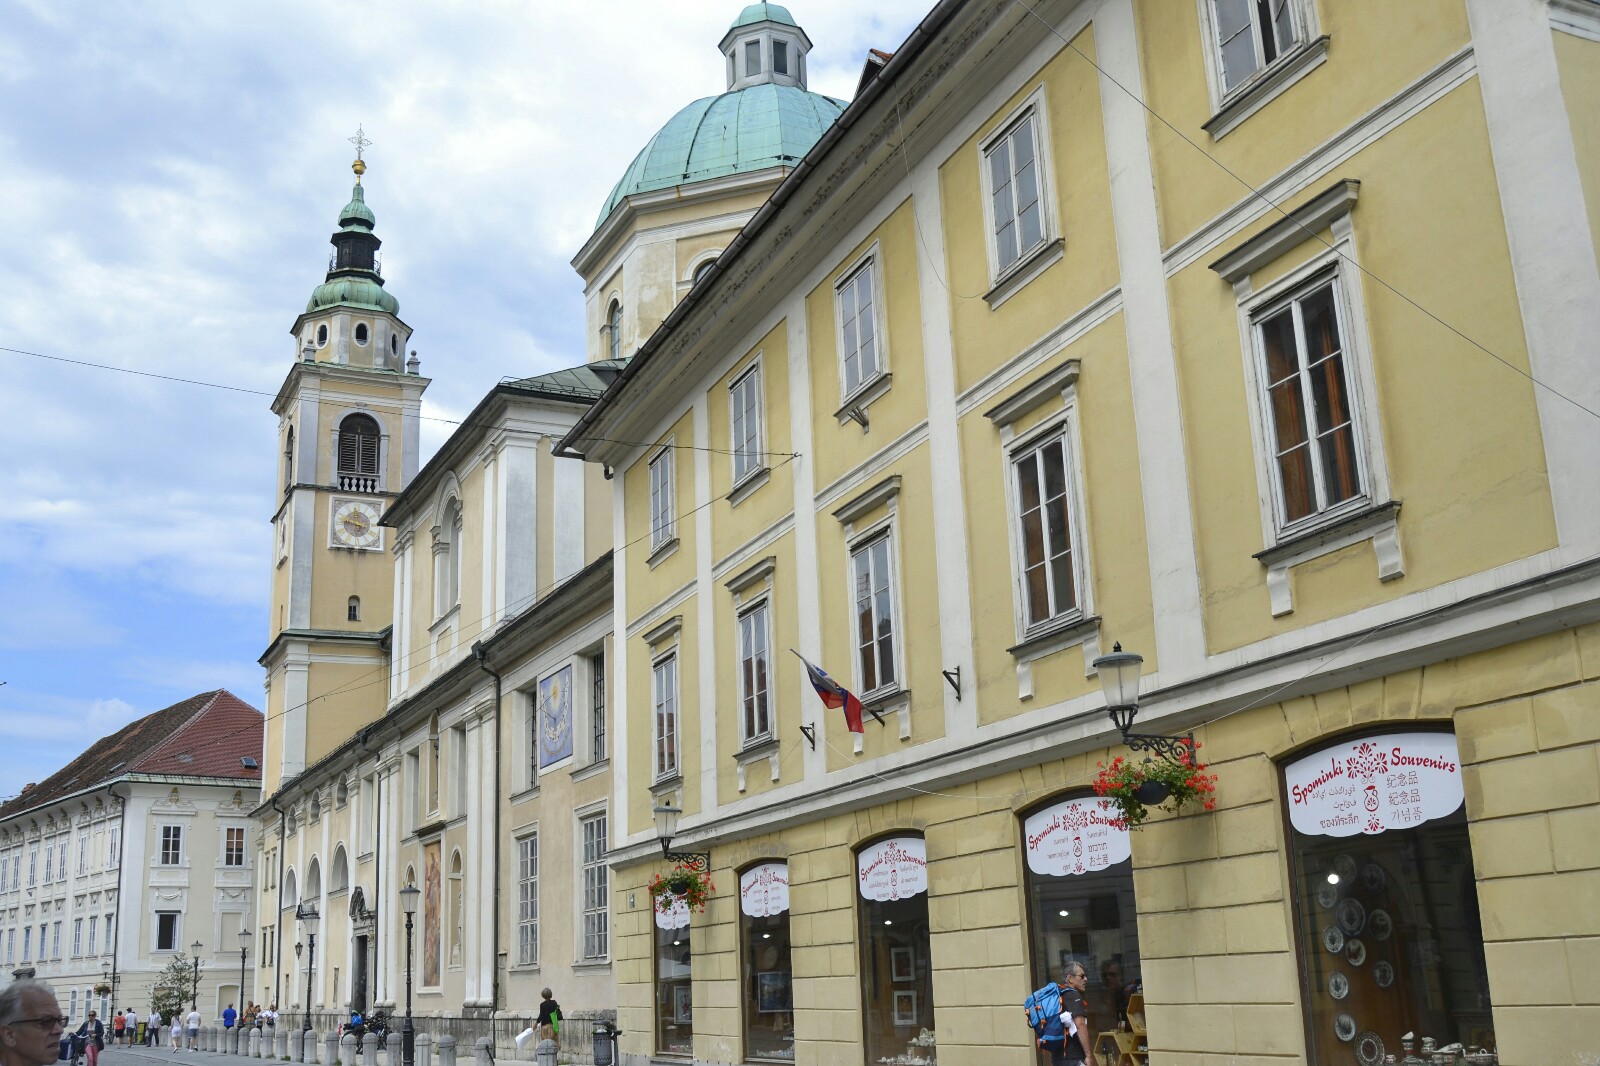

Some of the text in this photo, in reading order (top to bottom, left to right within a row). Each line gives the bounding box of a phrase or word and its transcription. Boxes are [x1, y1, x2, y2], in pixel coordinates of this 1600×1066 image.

[1292, 747, 1456, 805] Spominki Souvenirs
[1391, 806, 1423, 823] 기념품
[1028, 814, 1060, 851] Spominki
[861, 852, 883, 882] Spominki
